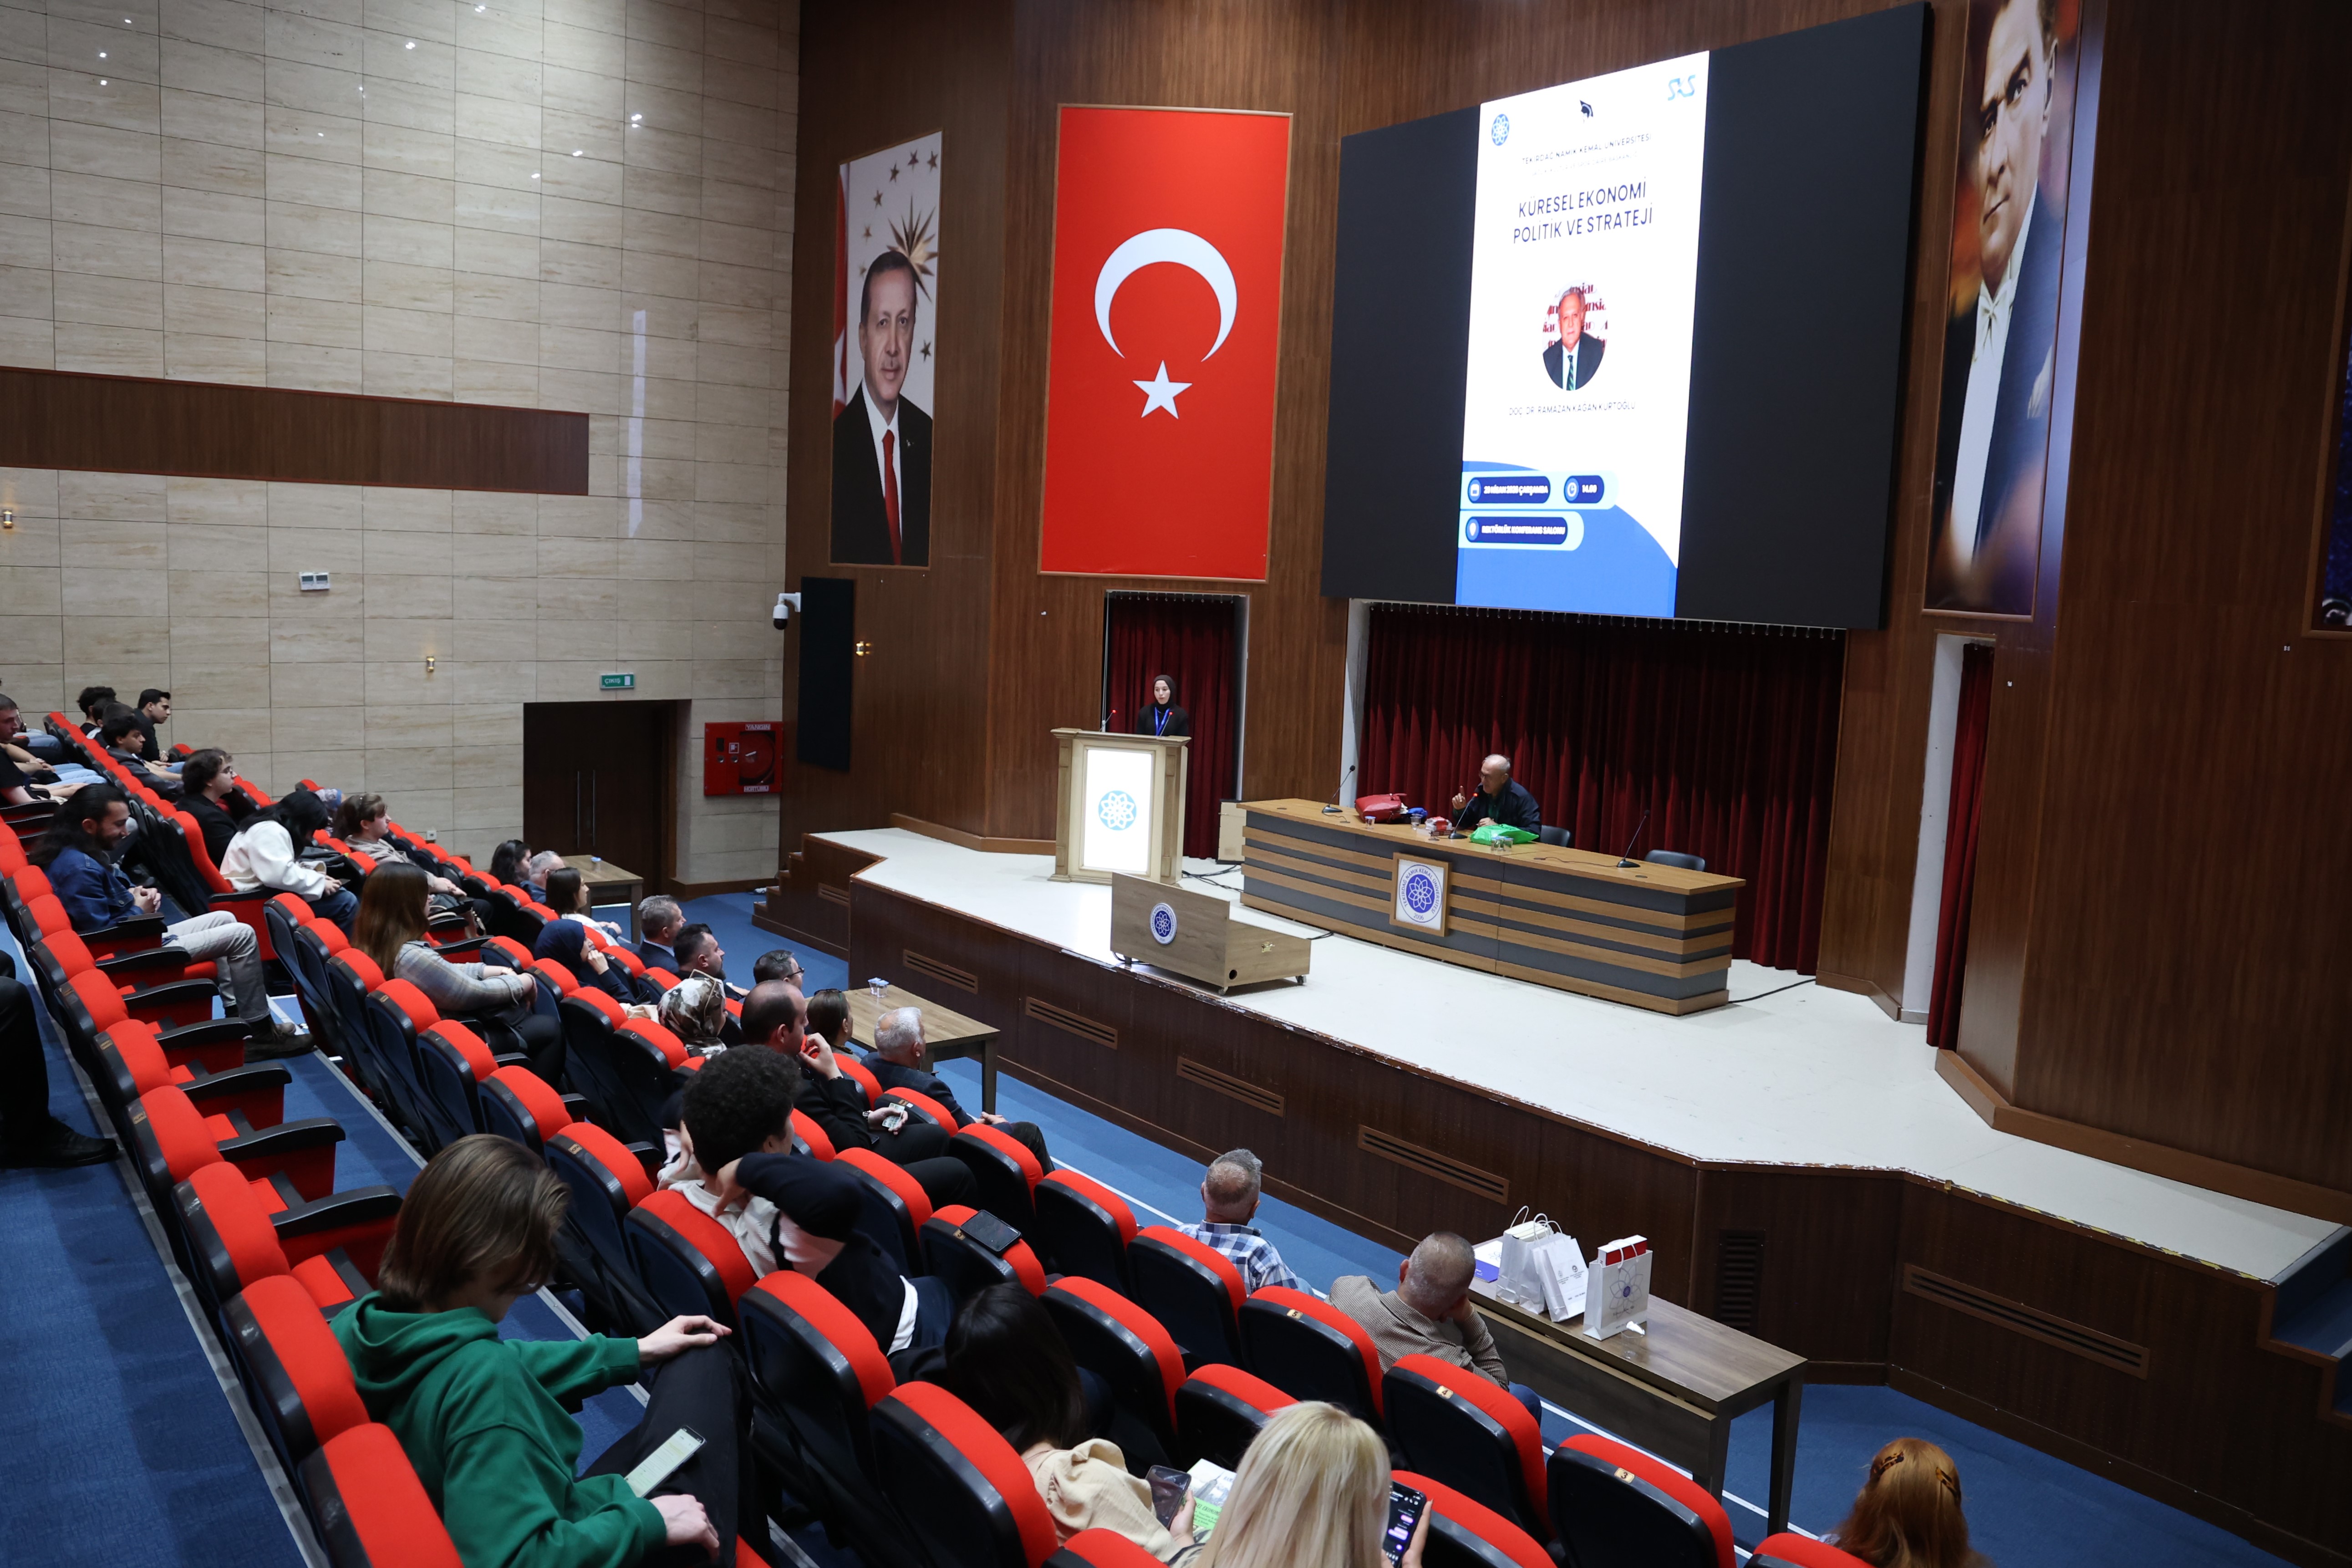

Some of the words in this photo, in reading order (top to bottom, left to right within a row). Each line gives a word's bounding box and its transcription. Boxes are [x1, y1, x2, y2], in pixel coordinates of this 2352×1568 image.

[1556, 149, 1577, 158] NAMIK
[1579, 143, 1602, 153] KEMAL
[1519, 194, 1574, 218] KÜRESEL
[1578, 177, 1646, 208] EKONOMİ
[1514, 218, 1562, 244] POLİTİK
[1567, 219, 1583, 235] VE
[1587, 202, 1653, 233] STRATEJİ
[1537, 404, 1571, 414] RAMAZAN
[1573, 401, 1597, 412] KAĞAN
[1599, 399, 1636, 411] KURTOĞLU
[1511, 526, 1543, 534] KONFERANS
[1543, 526, 1565, 535] SALONU
[1405, 868, 1418, 879] NAMIK
[1419, 868, 1432, 879] KEMAL
